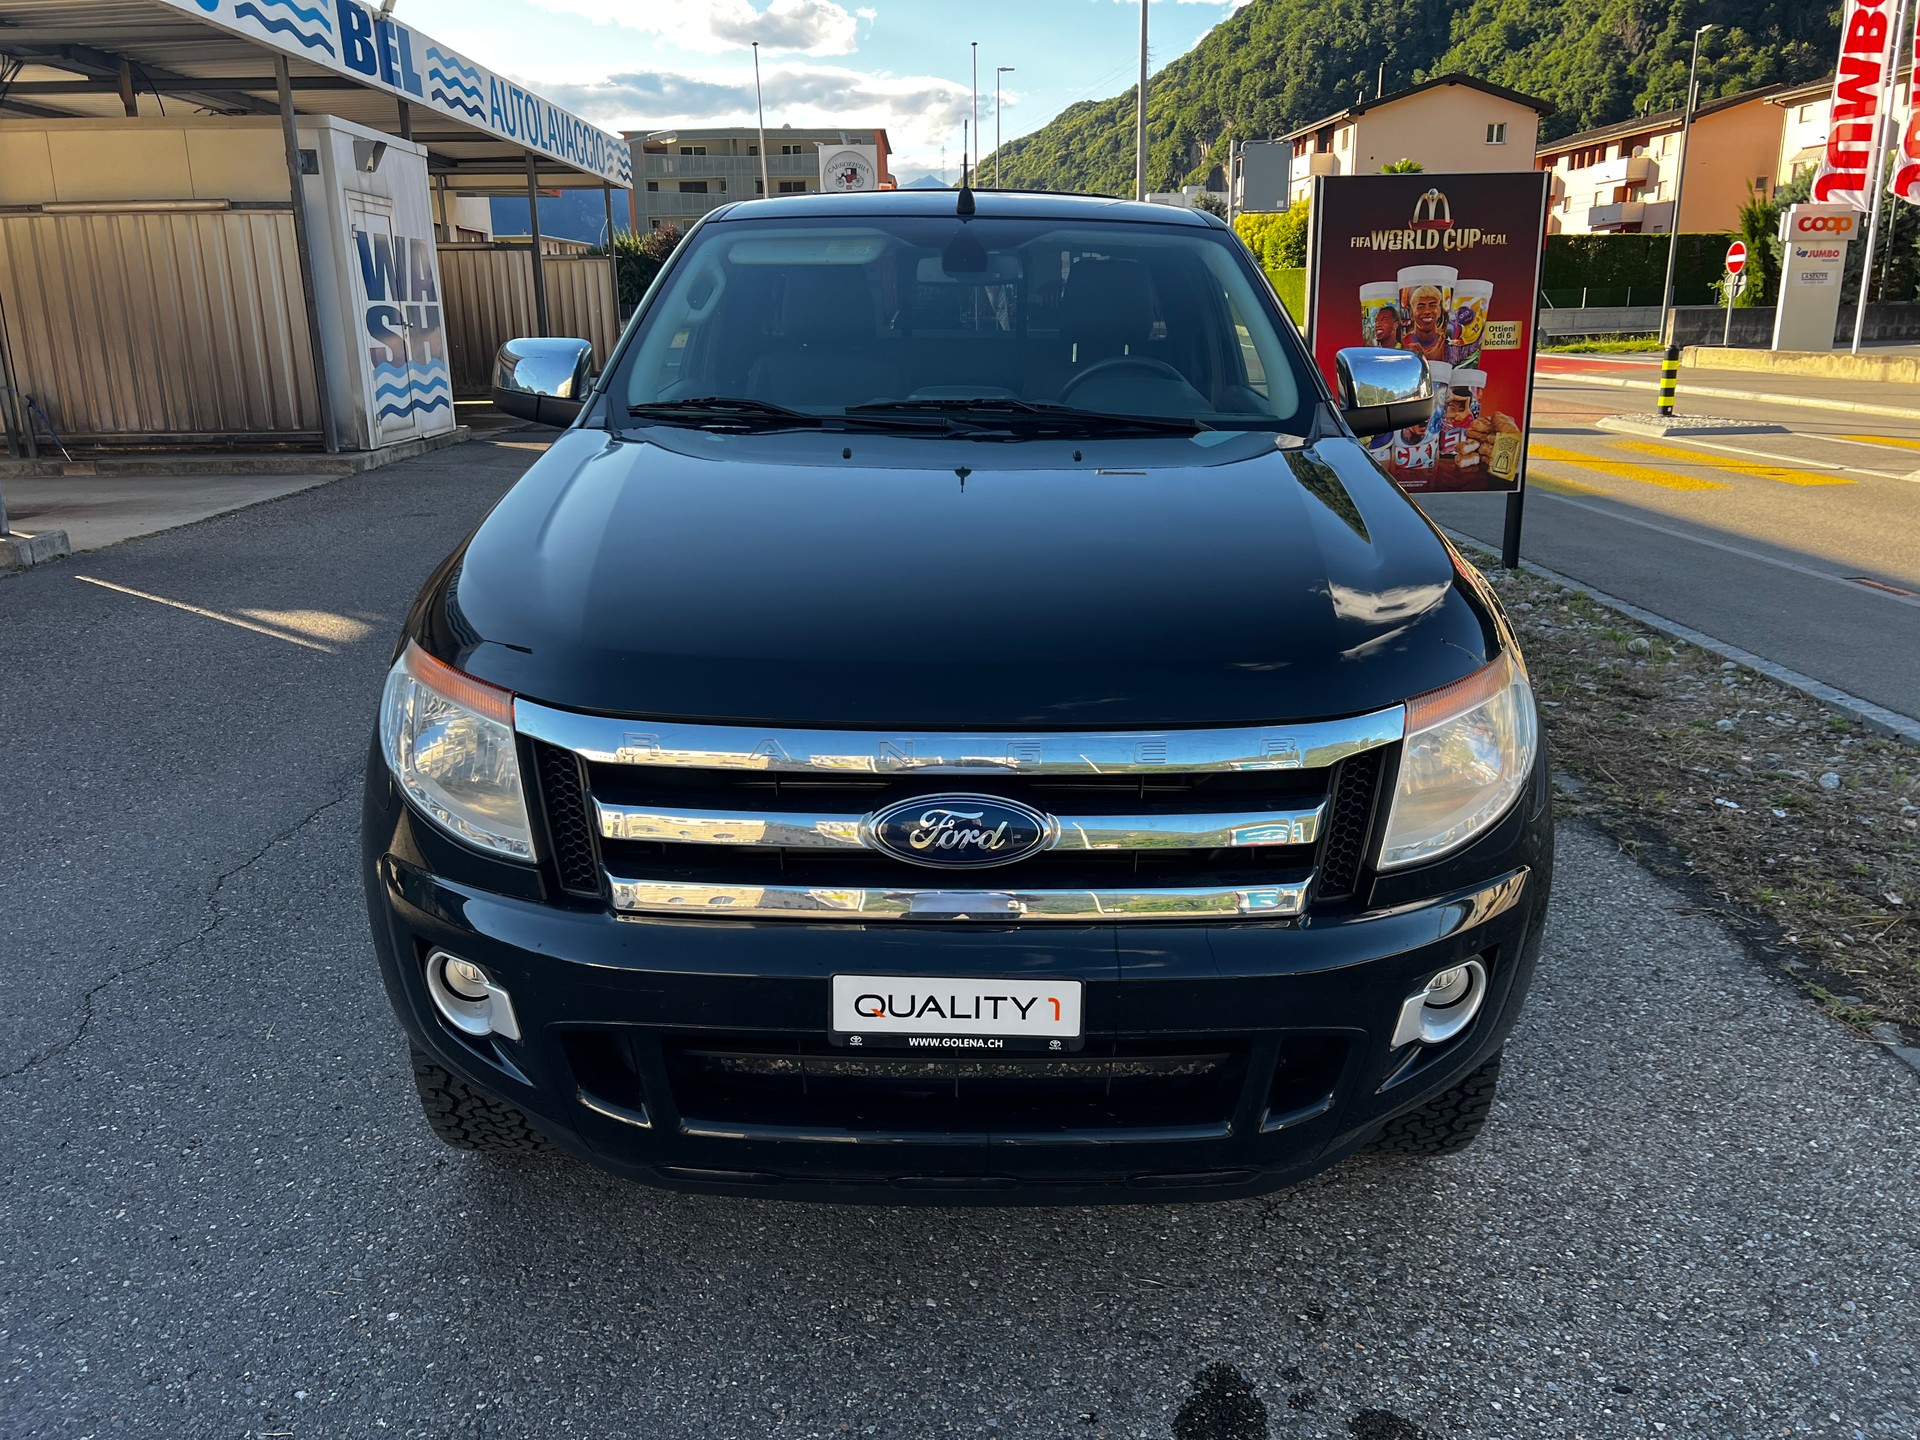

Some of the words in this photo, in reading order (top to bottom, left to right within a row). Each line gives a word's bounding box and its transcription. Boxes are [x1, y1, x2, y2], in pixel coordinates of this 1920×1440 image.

[336, 0, 424, 98] BEL
[1815, 0, 1888, 202] JUMB
[489, 75, 606, 174] AUTOLAVAGGIO
[827, 161, 869, 174] CARROZZERIA
[1798, 216, 1853, 235] coop
[1350, 236, 1371, 248] FIFA
[1371, 228, 1440, 251] WORLD
[1443, 228, 1482, 251] CUP
[1482, 234, 1508, 245] MEAL
[1807, 249, 1840, 258] JUMBO
[1488, 325, 1516, 333] Ottieni
[1484, 338, 1518, 346] bicchieri
[909, 809, 1008, 850] Ford
[854, 994, 1038, 1020] QUALITY
[1048, 997, 1061, 1022] 1
[908, 1037, 1003, 1048] WWW.GOLENA.CH
